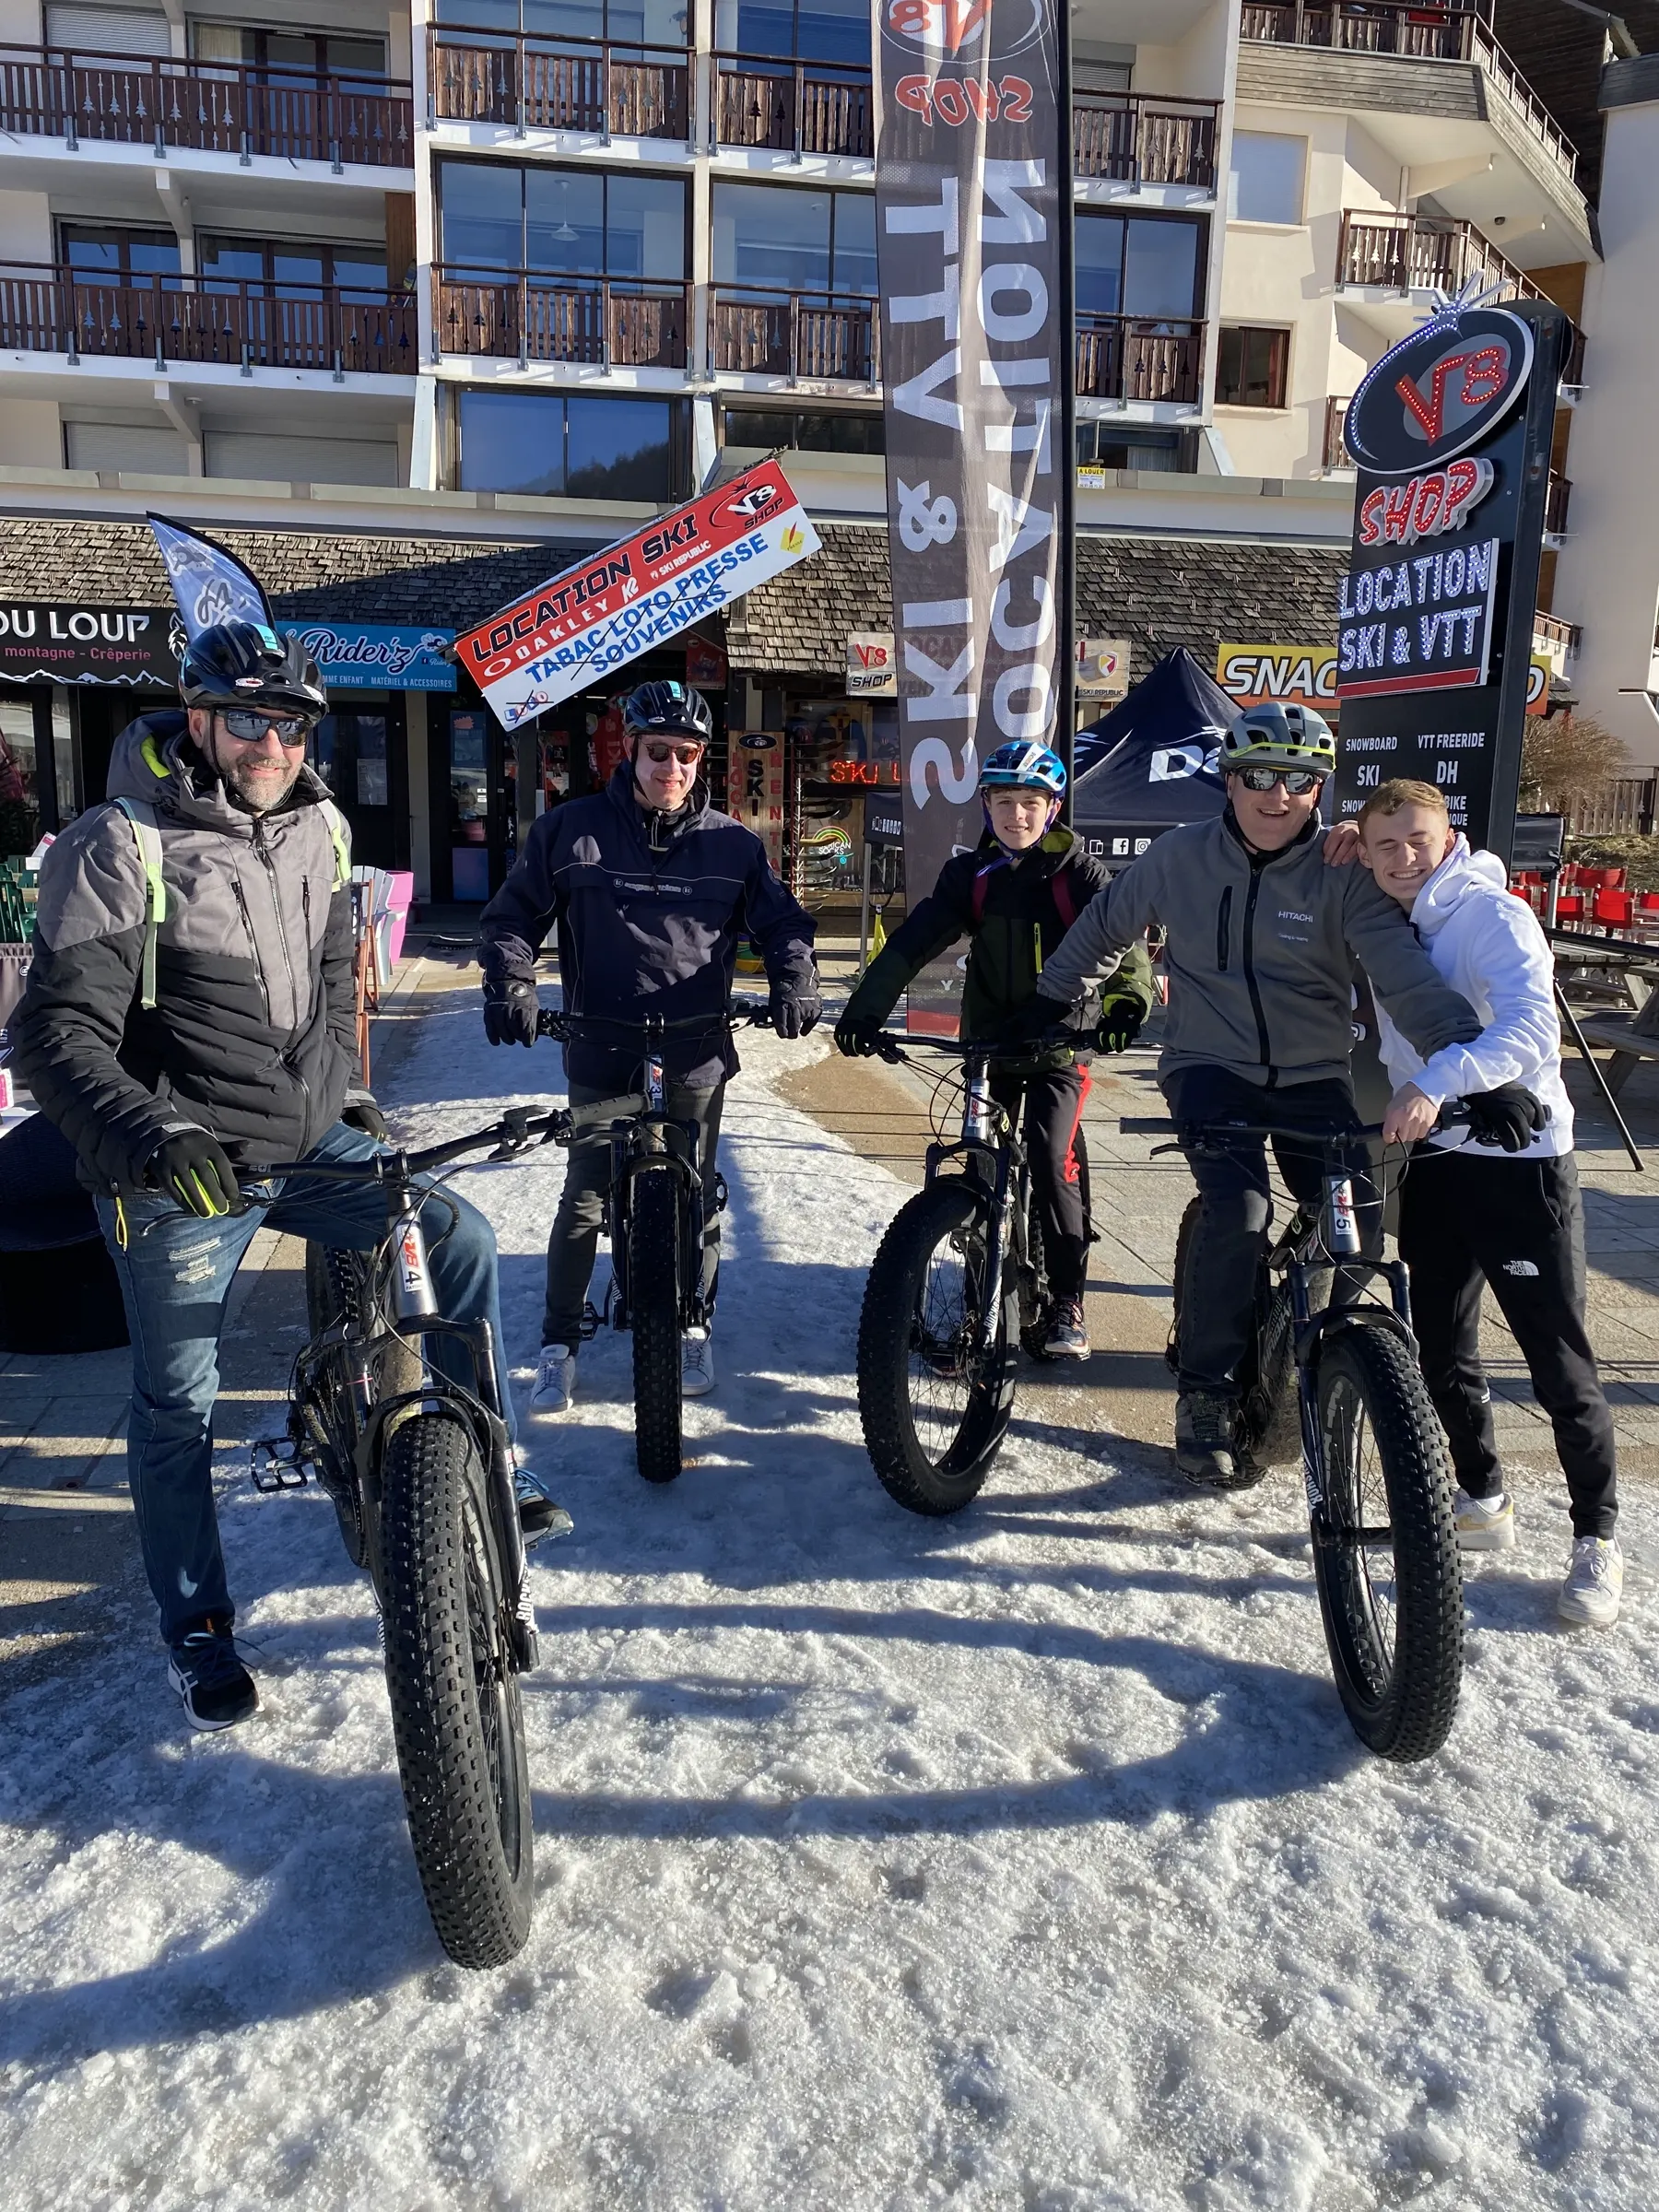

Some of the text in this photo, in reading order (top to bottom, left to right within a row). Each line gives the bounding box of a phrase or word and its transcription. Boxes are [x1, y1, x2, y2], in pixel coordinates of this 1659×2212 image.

[1395, 345, 1509, 446] V8
[727, 485, 776, 515] V8
[745, 497, 783, 530] SHOP
[1359, 459, 1479, 545] SHOP
[659, 540, 712, 575] SKI REPUBLIC
[472, 514, 699, 663] LOCATION SKI
[1338, 540, 1492, 620] LOCATION
[515, 577, 640, 660] OAKLEY K2
[524, 533, 770, 683] TABAC LOTO PRESSE
[591, 583, 726, 673] SOUVENIRS
[1339, 606, 1482, 672] SKI & VTT
[5, 646, 76, 662] montagne
[89, 647, 151, 663] Crêperie
[853, 642, 888, 670] V8
[323, 675, 363, 685] MME ENFANT
[371, 676, 401, 686] MATÉRIEL
[410, 678, 453, 688] ACCESSOIRES
[851, 674, 892, 688] SHOP
[1224, 655, 1338, 699] SNAC
[1346, 736, 1398, 752] SNOWBOARD
[1418, 733, 1486, 749] VTT FREERIDE
[747, 759, 764, 816] SKI
[1357, 764, 1380, 786] SKI
[1436, 761, 1459, 784] DH
[770, 752, 782, 872] RENTA
[1277, 911, 1313, 924] HITACHI
